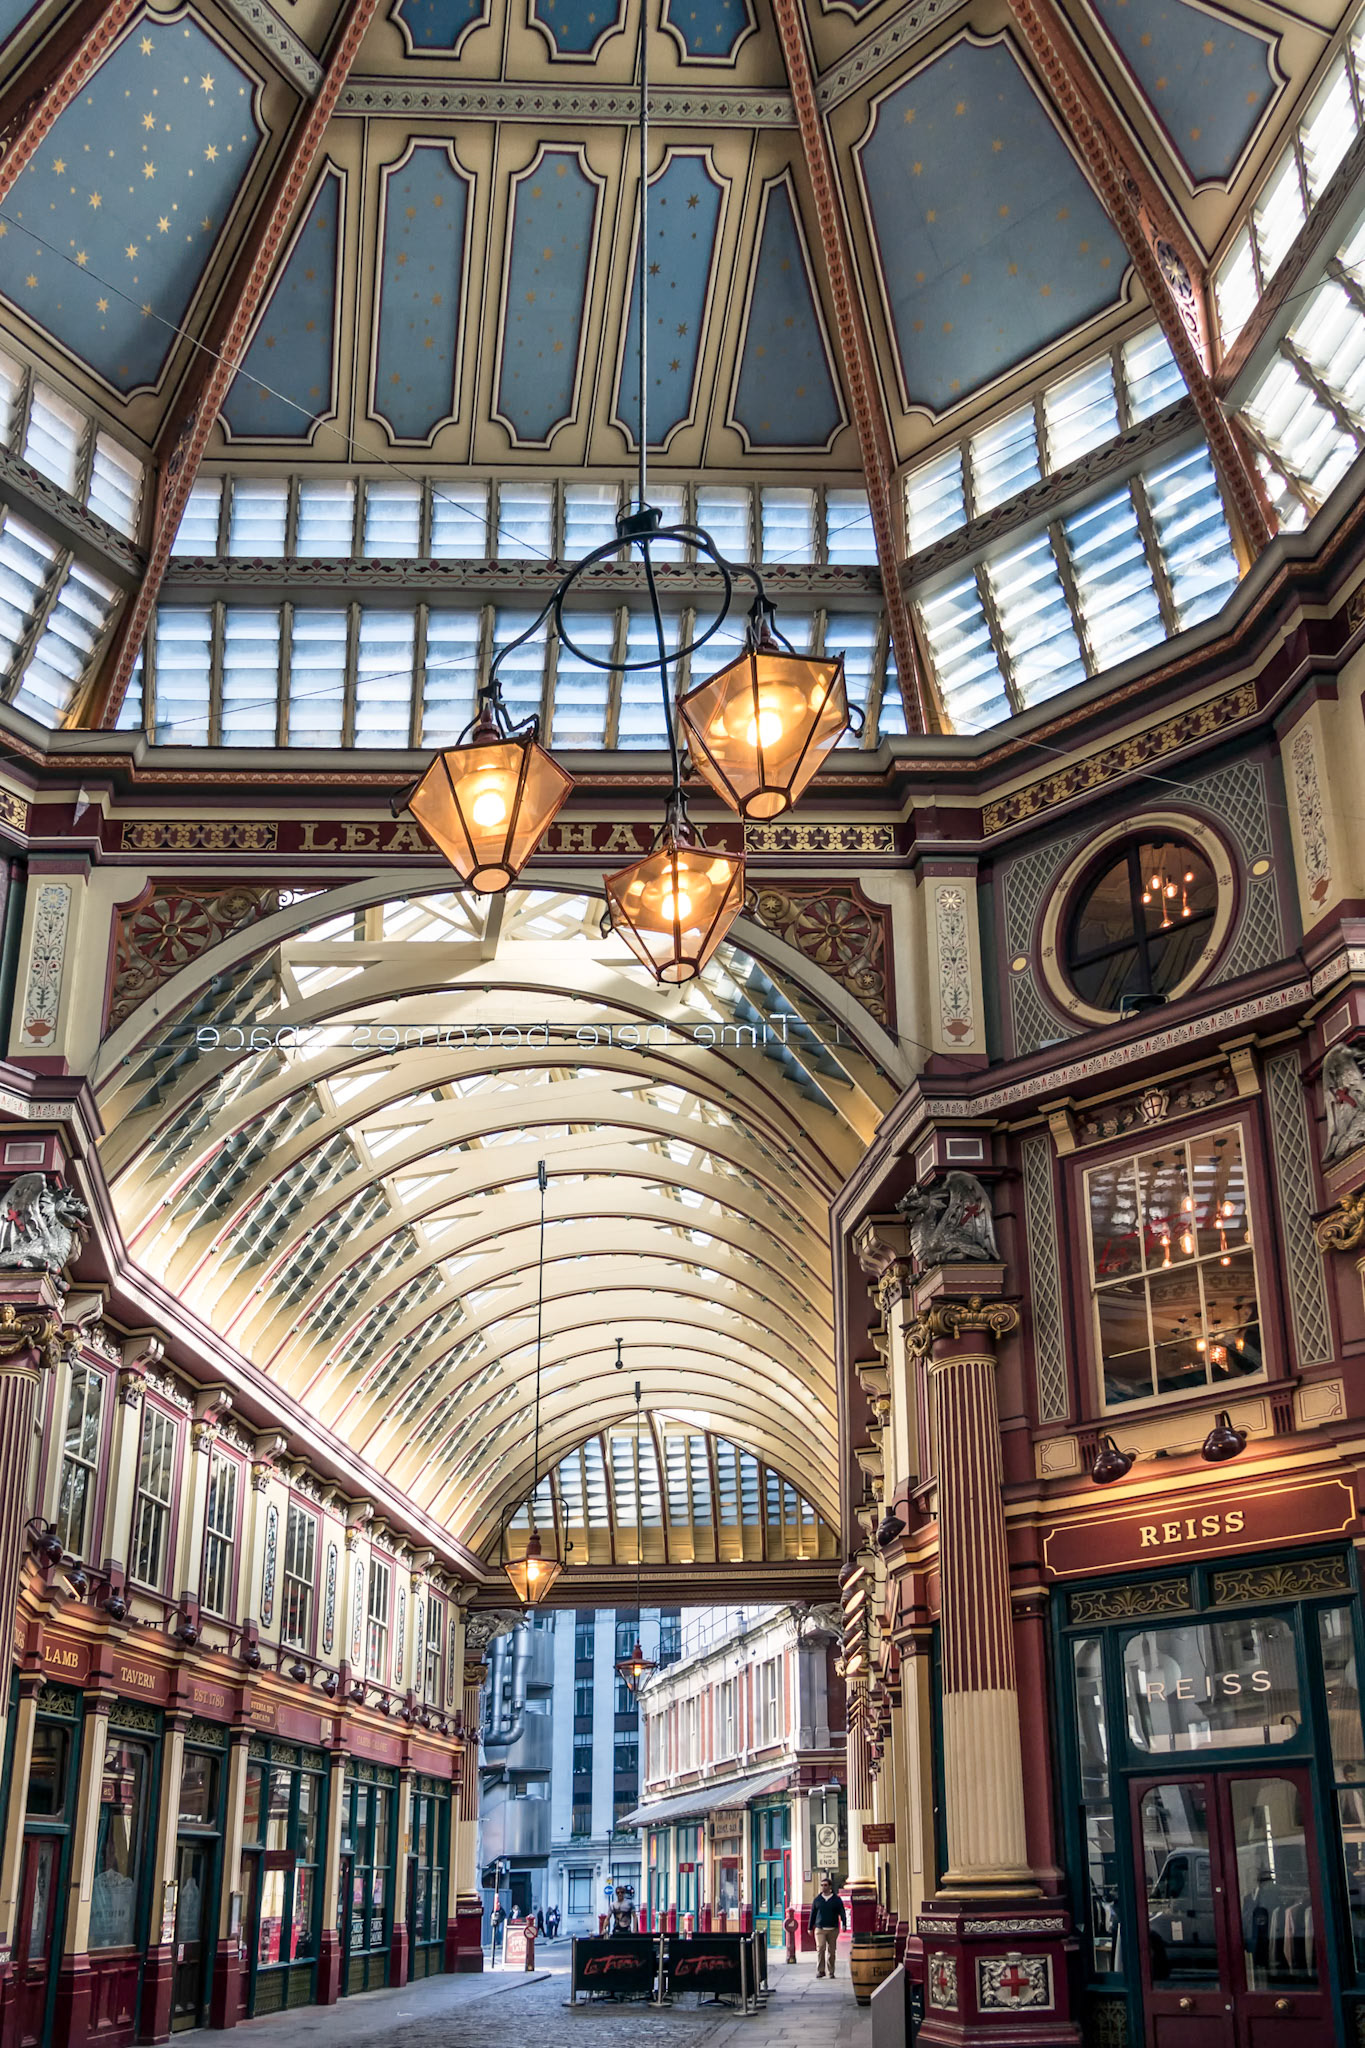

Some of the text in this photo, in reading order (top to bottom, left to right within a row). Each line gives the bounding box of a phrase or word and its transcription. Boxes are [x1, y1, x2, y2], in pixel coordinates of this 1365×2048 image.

[1139, 1510, 1244, 1547] REISS
[45, 1646, 79, 1668] LAMB
[120, 1667, 156, 1689] TAVERN
[1146, 1670, 1272, 1703] REISS
